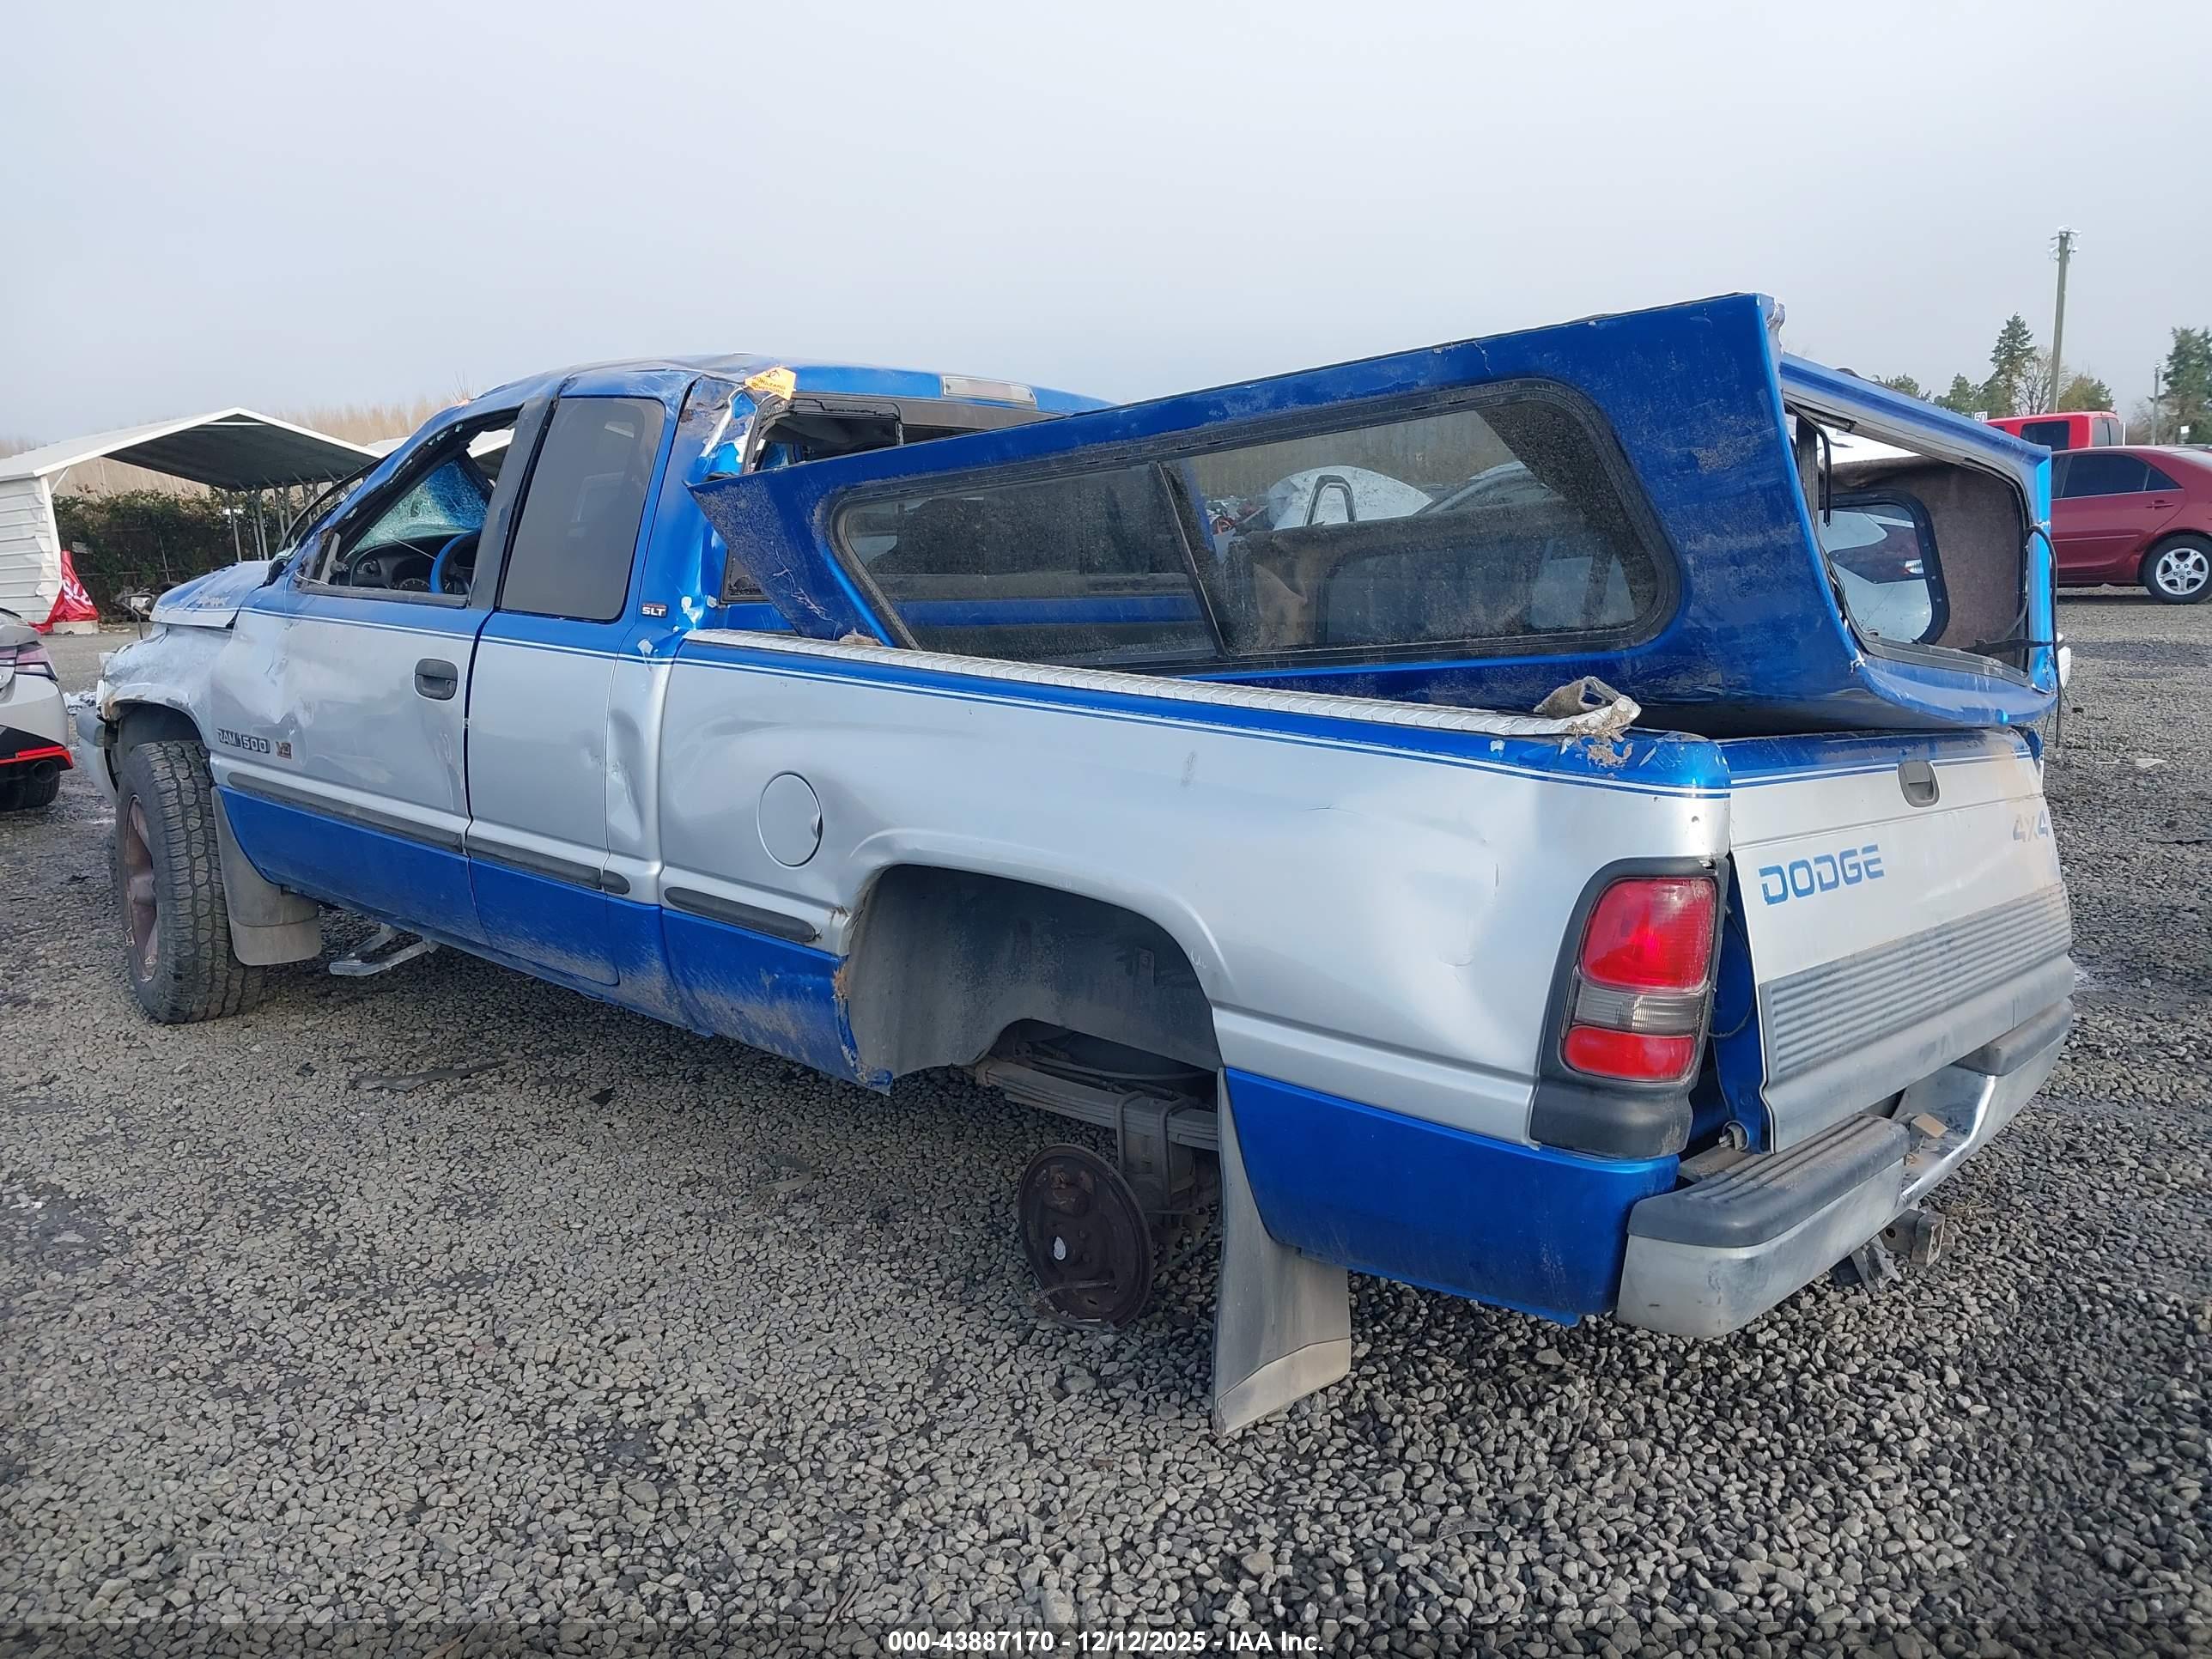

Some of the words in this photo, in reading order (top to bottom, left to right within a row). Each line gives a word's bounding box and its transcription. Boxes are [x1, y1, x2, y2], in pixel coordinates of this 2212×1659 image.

[641, 606, 666, 617] SLT
[216, 728, 239, 747] RAM
[239, 734, 270, 753] 1500
[1759, 843, 1884, 905] DODGE
